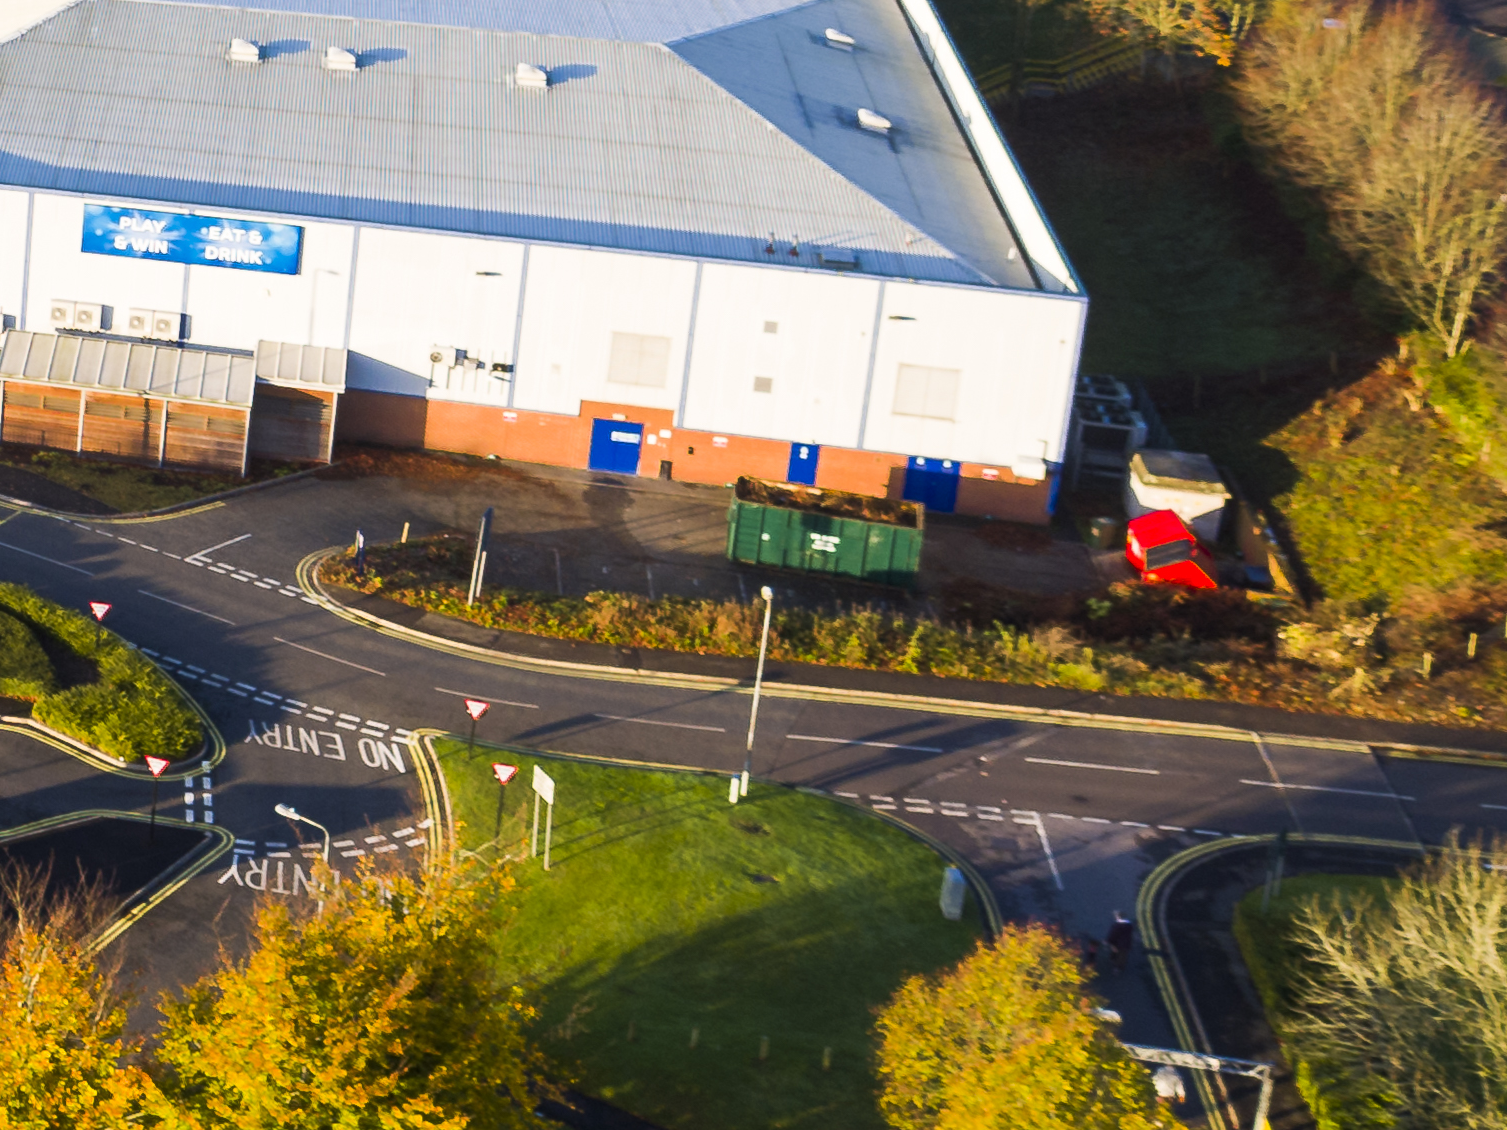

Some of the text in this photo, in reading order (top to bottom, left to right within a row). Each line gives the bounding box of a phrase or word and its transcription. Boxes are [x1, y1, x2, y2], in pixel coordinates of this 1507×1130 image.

[118, 216, 166, 234] PLAY
[208, 225, 264, 245] EAT &
[113, 235, 169, 254] & WIN
[204, 245, 263, 265] DRINK
[244, 719, 406, 773] NO ENTRY
[217, 854, 341, 896] NTRY
